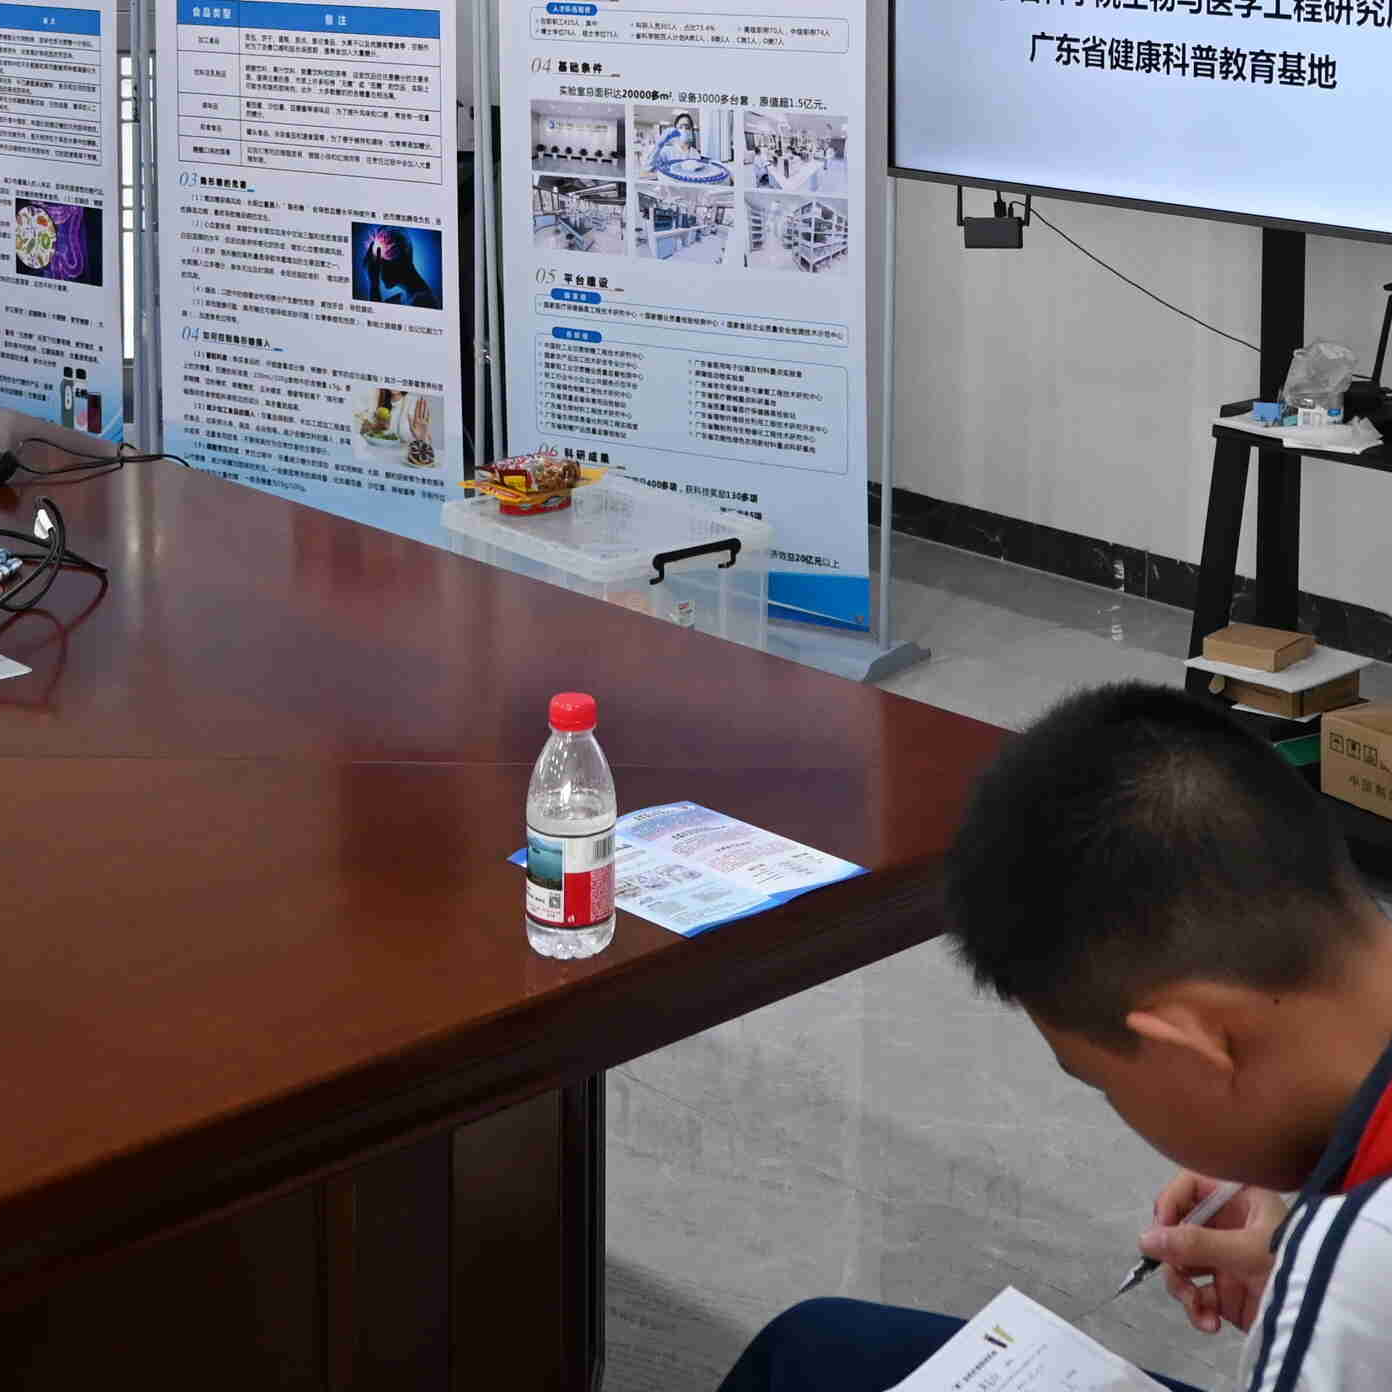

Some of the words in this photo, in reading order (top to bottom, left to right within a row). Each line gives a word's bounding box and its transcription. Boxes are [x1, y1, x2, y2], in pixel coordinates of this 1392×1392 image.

[1027, 31, 1339, 93] 广东省健康科普教育基地
